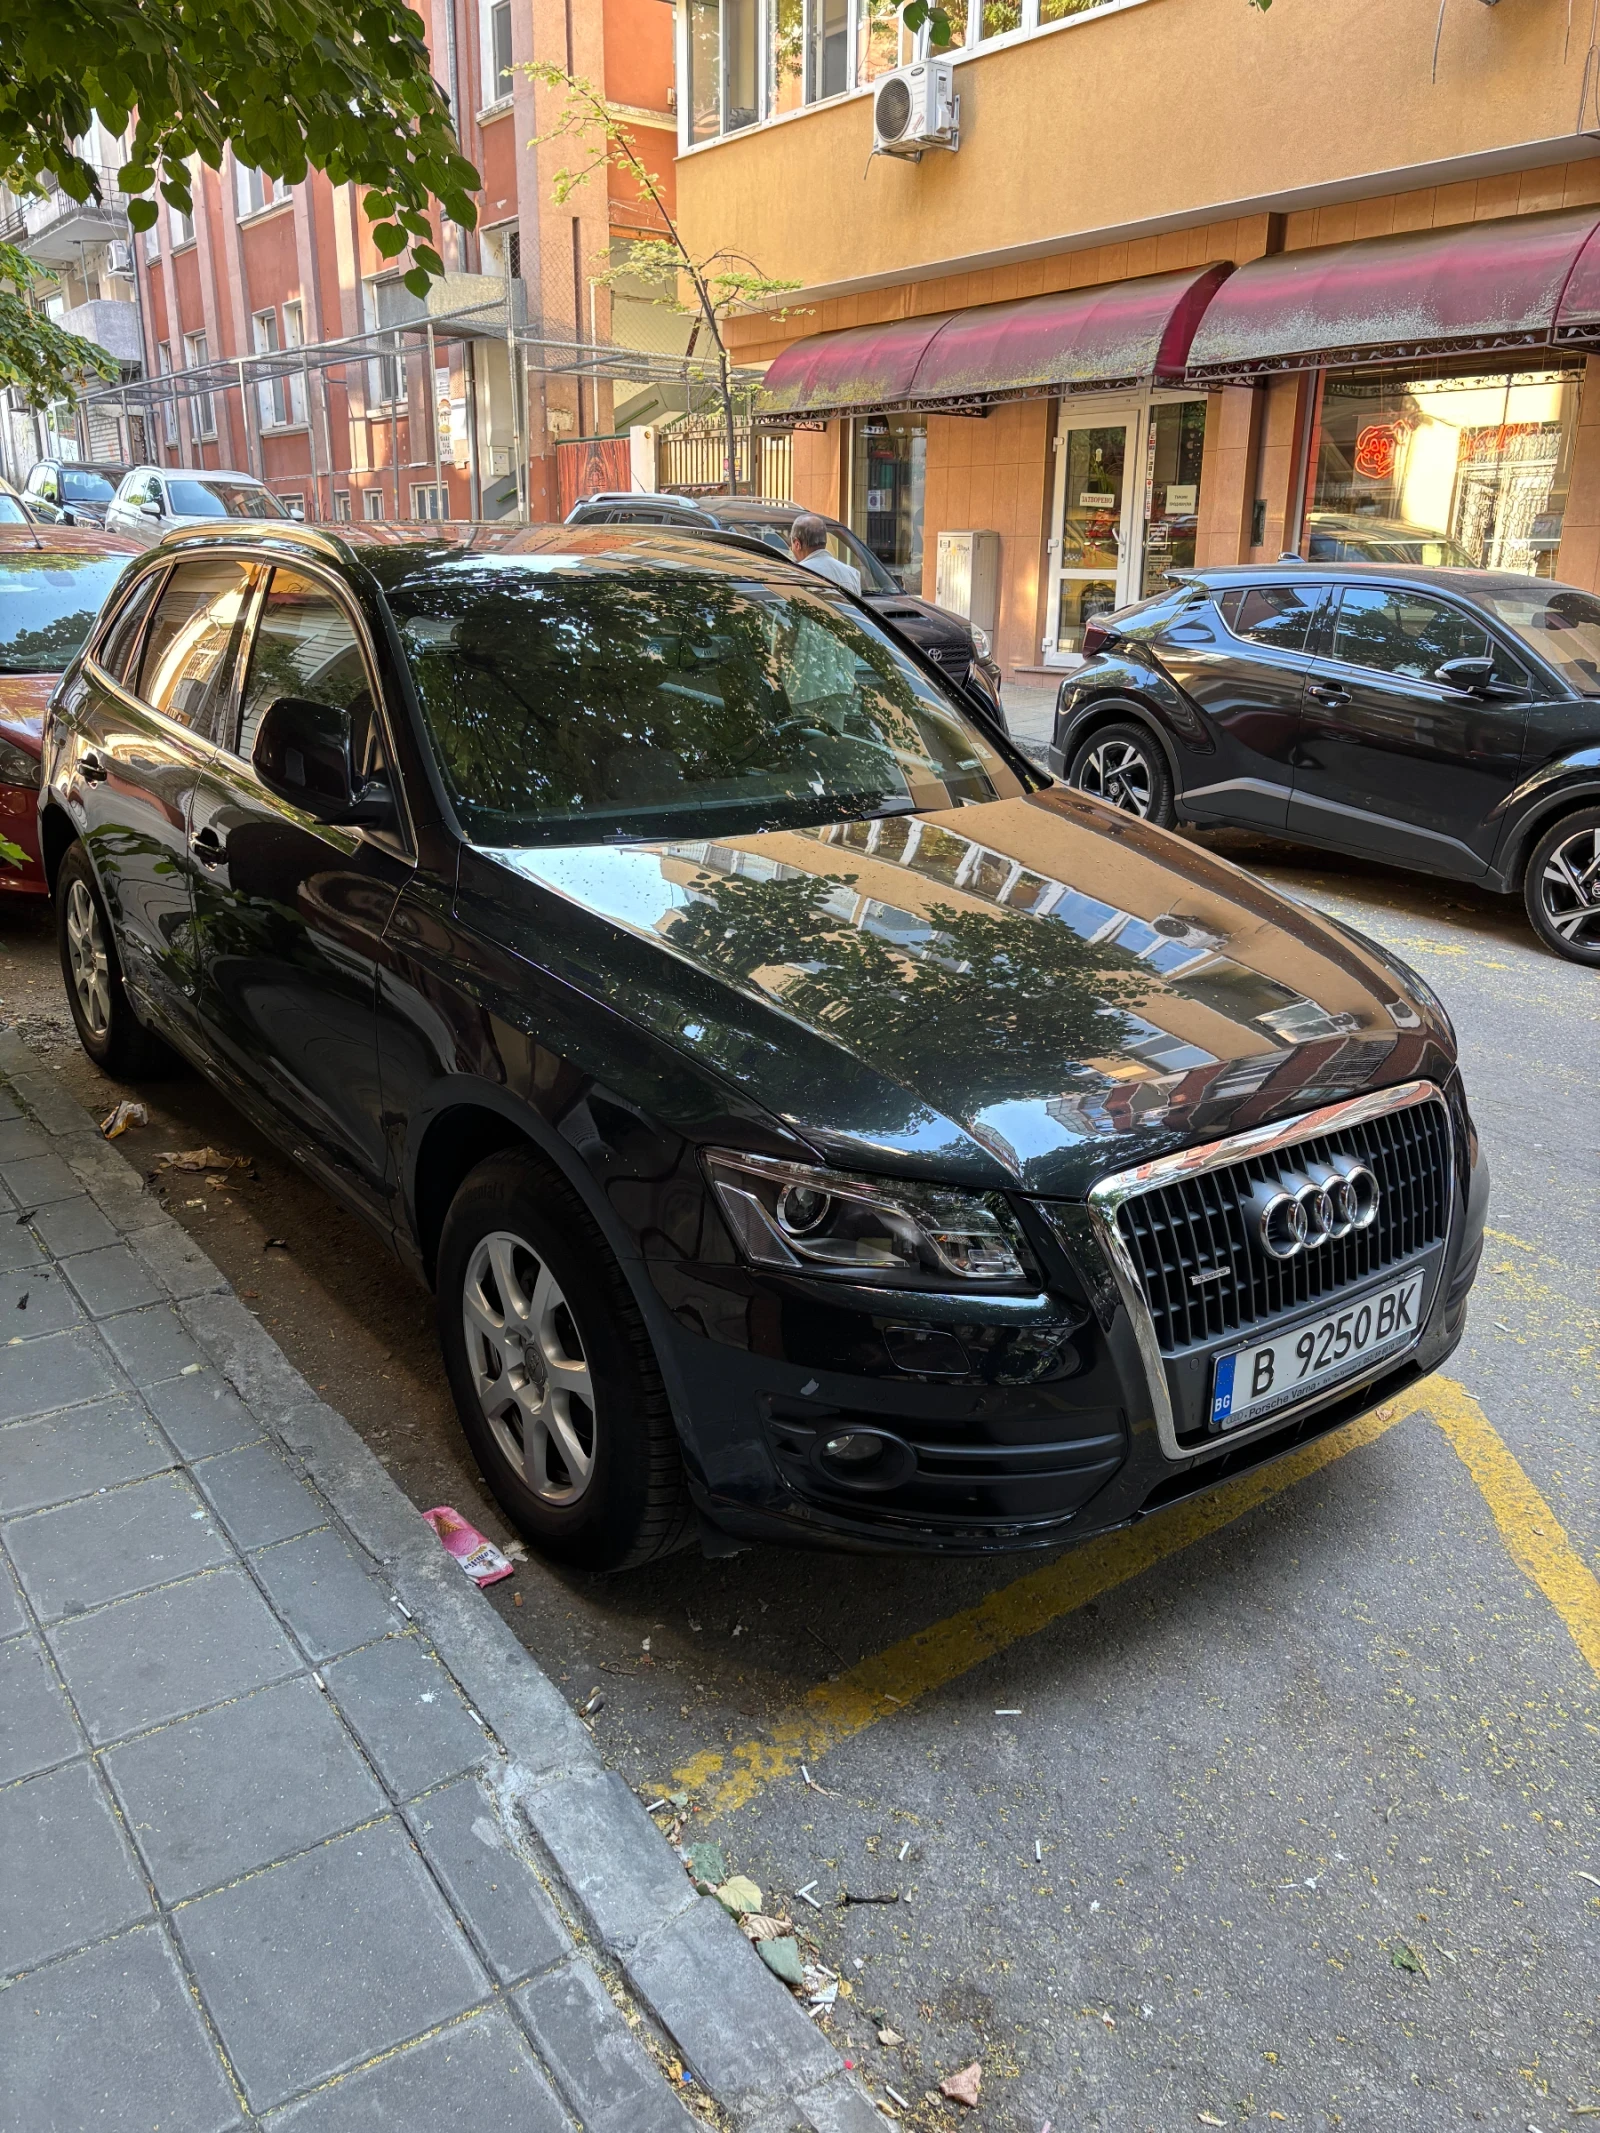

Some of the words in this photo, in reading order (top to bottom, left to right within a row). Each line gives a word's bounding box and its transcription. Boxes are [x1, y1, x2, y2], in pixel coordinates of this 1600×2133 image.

[1082, 496, 1113, 504] ЗАТВОРЕНО
[1195, 1267, 1230, 1283] quattro
[1251, 1346, 1274, 1398] B
[1296, 1306, 1372, 1378] 9250
[1376, 1283, 1417, 1339] BK
[1214, 1395, 1231, 1413] BG
[1249, 1394, 1289, 1417] Porsche
[1291, 1383, 1316, 1402] Varna
